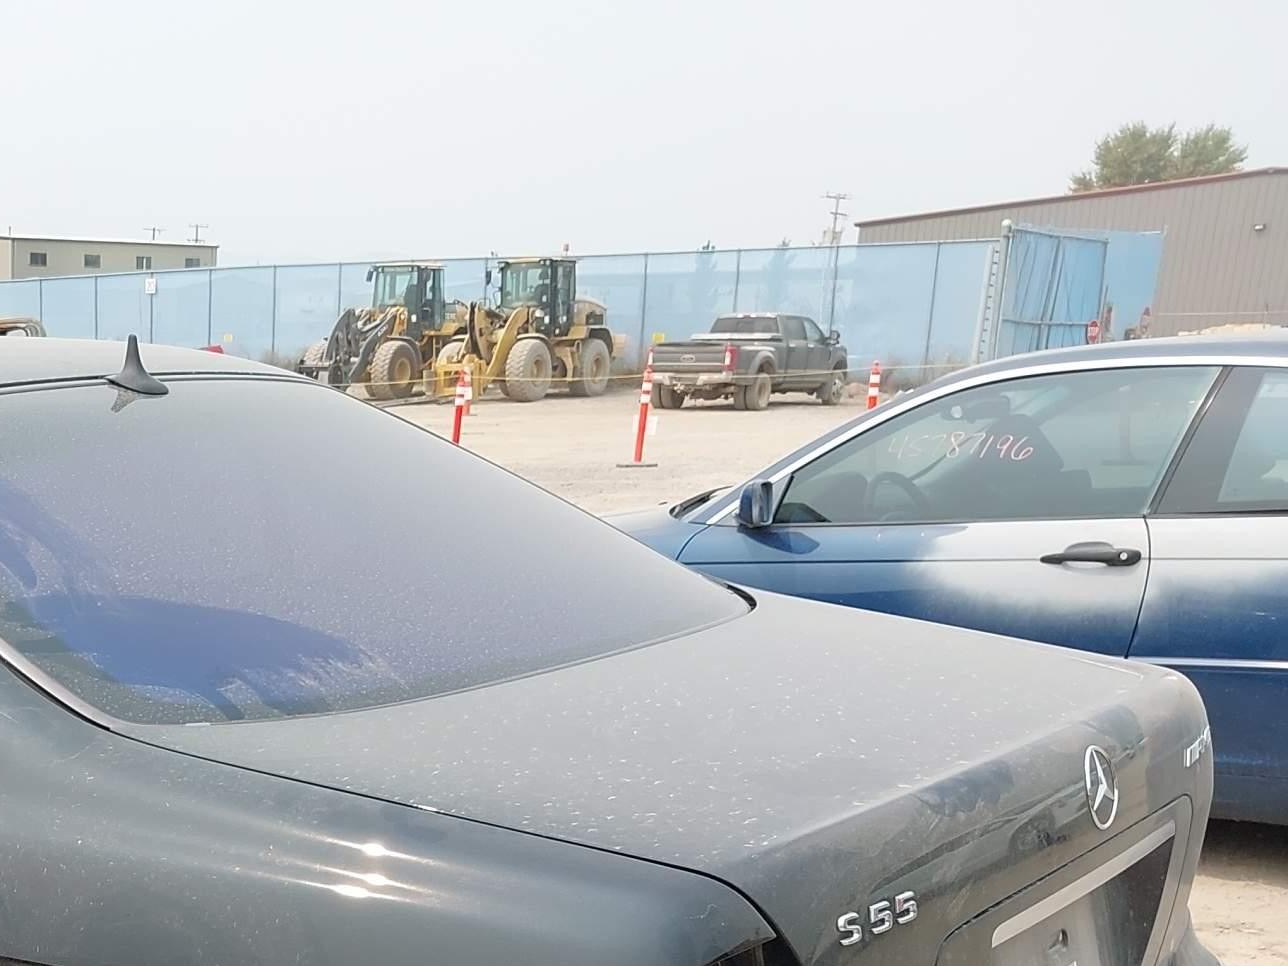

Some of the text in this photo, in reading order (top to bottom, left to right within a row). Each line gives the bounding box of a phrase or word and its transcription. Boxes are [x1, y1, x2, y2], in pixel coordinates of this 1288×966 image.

[887, 431, 1034, 461] 45787196
[837, 890, 918, 946] S 55
